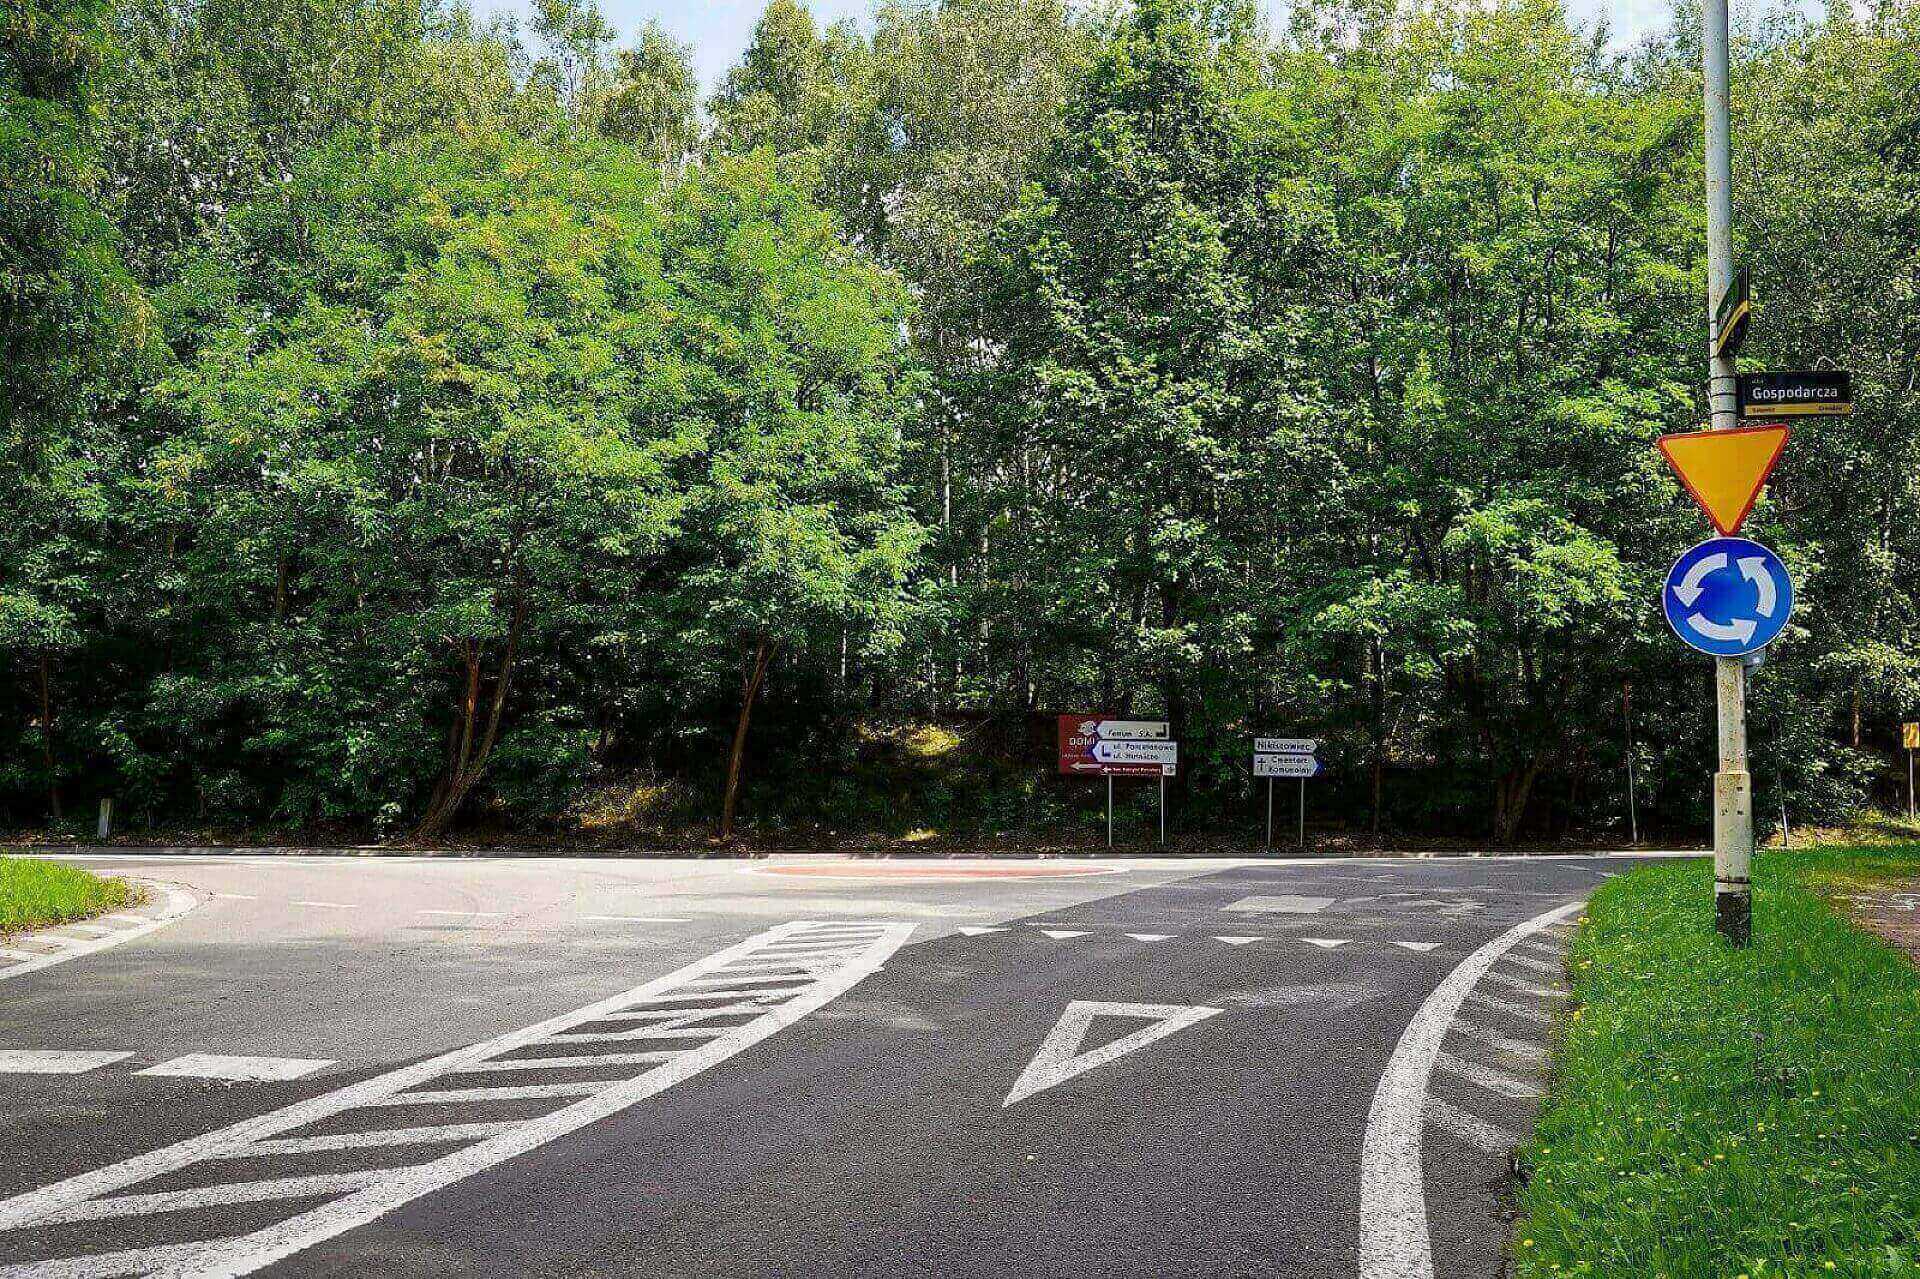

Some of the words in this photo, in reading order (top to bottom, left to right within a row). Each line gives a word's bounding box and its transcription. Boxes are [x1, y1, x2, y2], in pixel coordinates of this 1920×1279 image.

[1752, 385, 1838, 401] Gospodarcza
[1257, 741, 1310, 750] Nikiszowiec
[1271, 755, 1308, 764] Cmentarz
[1268, 767, 1310, 775] Komunalny
